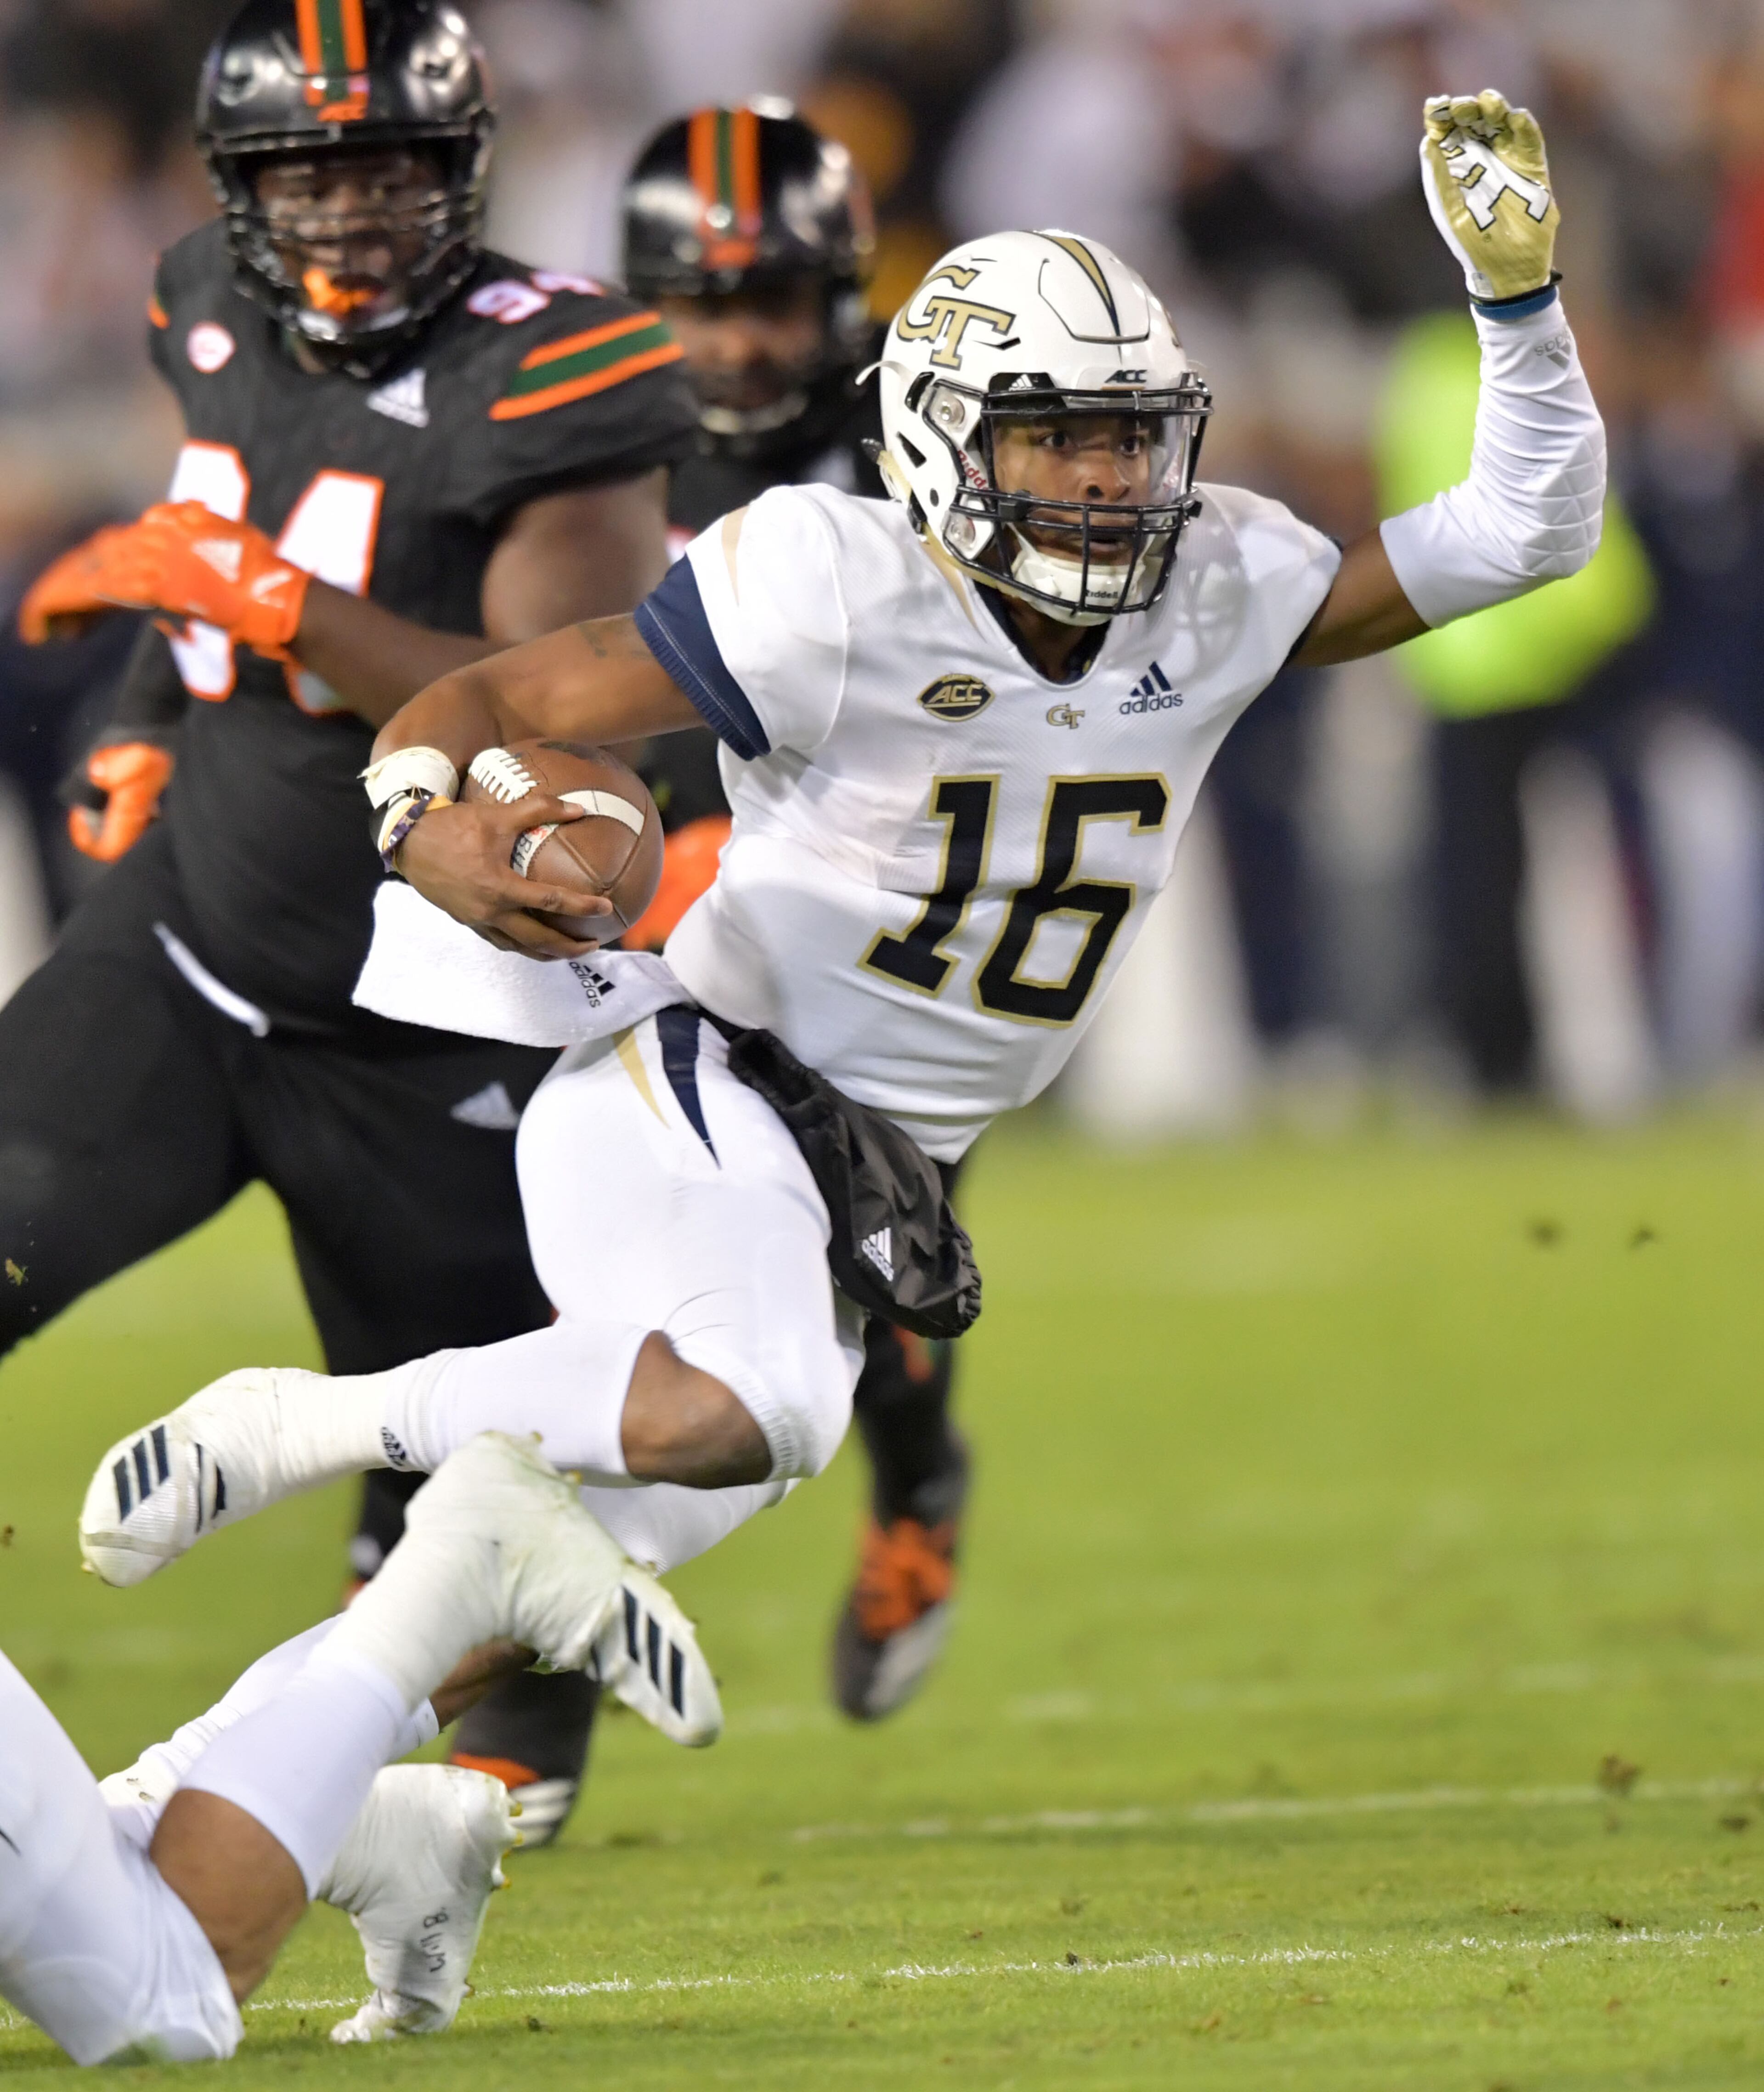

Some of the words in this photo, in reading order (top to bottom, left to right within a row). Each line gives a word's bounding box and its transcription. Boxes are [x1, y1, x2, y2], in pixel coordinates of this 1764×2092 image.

[897, 265, 1017, 371] GT
[1104, 369, 1147, 384] ACC
[926, 684, 984, 704] ACC
[1119, 693, 1183, 715] adidas
[1046, 703, 1085, 729] GT
[857, 772, 1172, 1028] 16
[569, 962, 601, 1007] adidas
